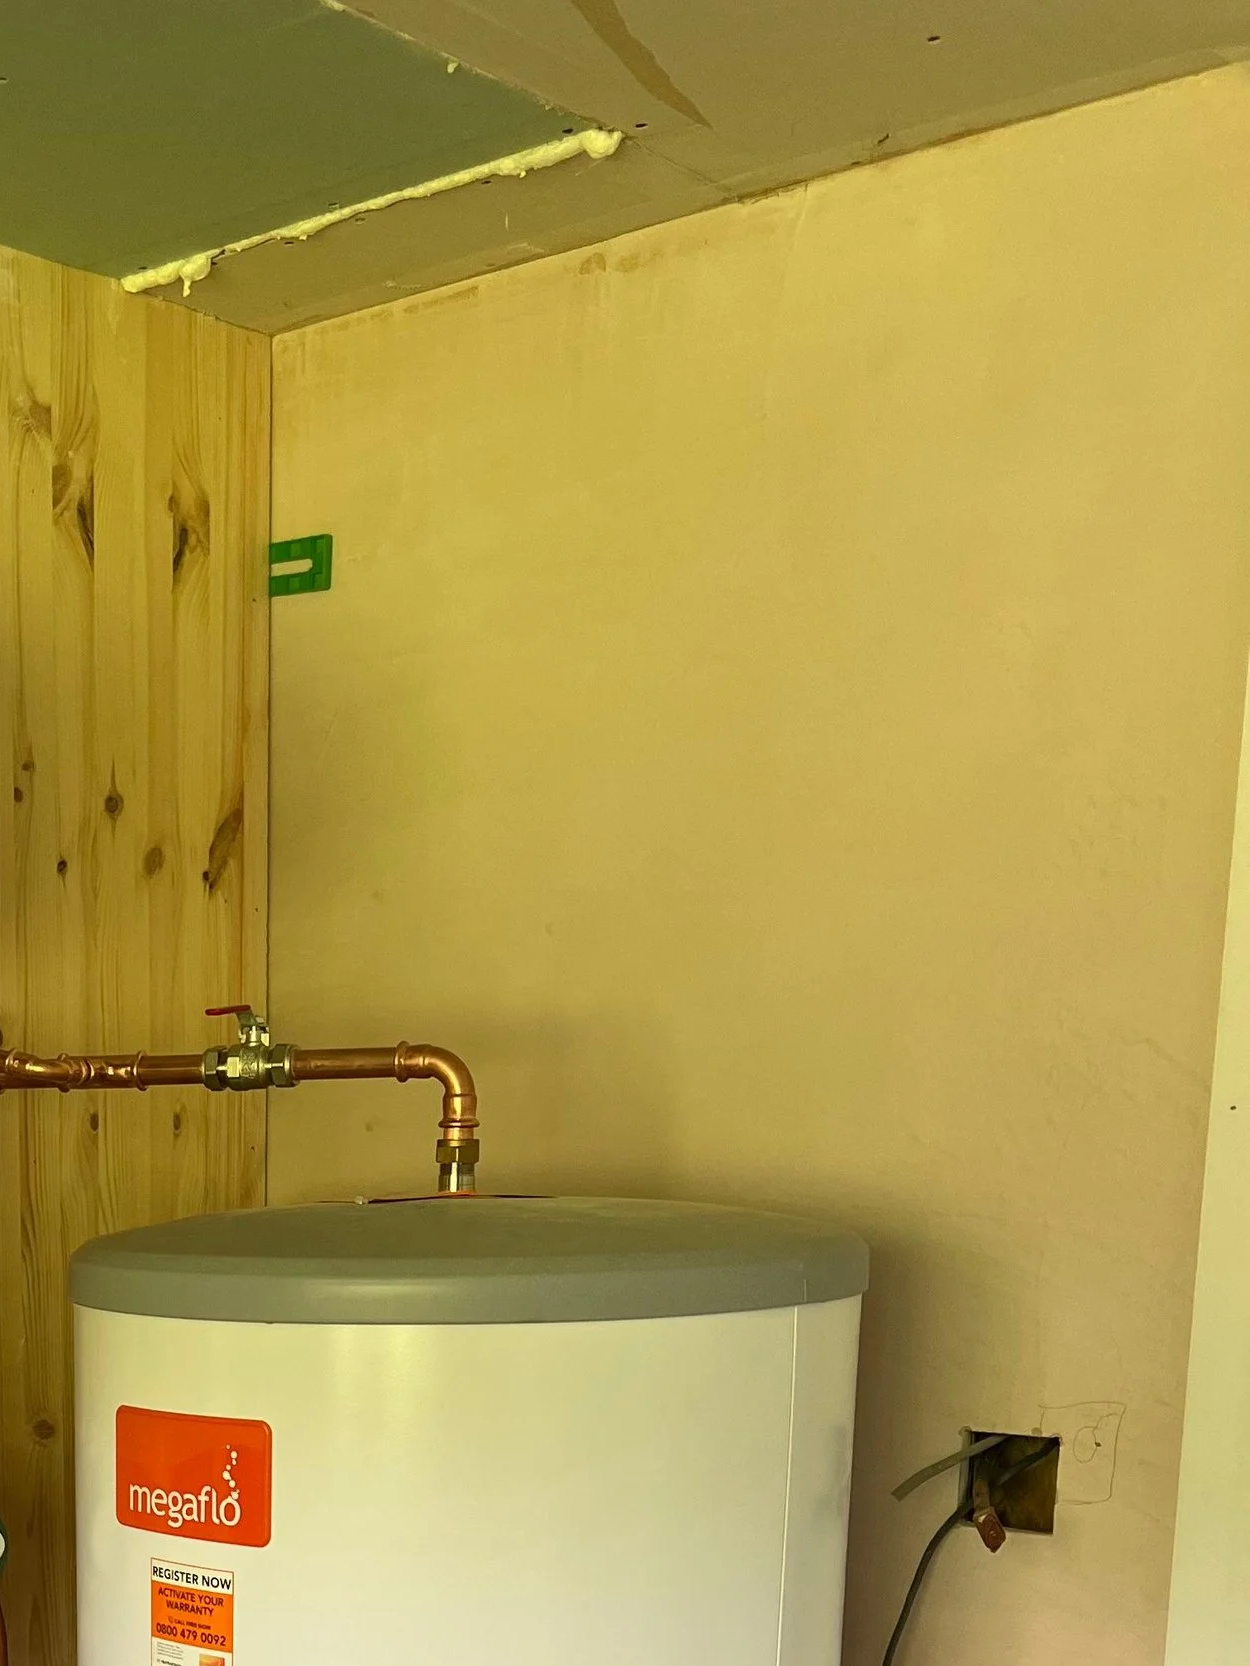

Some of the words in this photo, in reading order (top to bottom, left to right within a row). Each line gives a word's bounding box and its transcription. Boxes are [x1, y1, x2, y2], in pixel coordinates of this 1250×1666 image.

[129, 1483, 241, 1529] megaflo
[152, 1566, 199, 1586] REGISTER
[201, 1575, 232, 1590] NOW
[158, 1587, 195, 1603] ACTIVATE
[197, 1593, 224, 1607] YOUR
[166, 1599, 214, 1617] WARRANTY
[156, 1623, 179, 1639] 0800
[180, 1629, 198, 1642] 479
[200, 1633, 226, 1647] 0092
